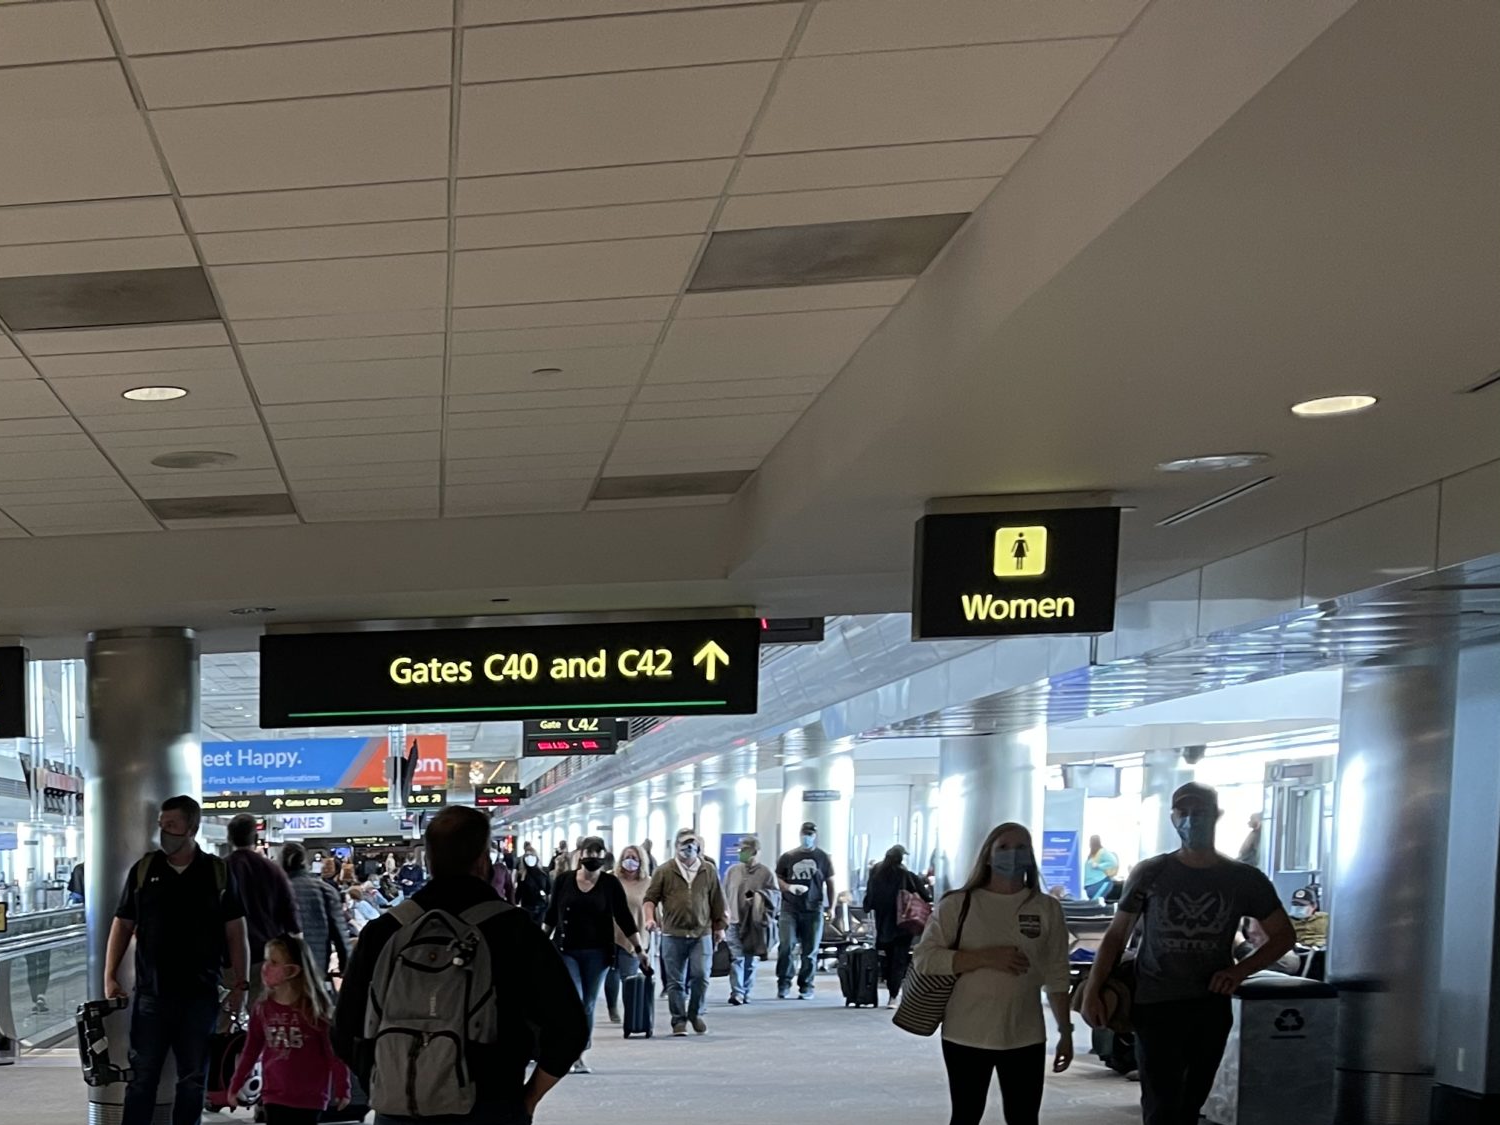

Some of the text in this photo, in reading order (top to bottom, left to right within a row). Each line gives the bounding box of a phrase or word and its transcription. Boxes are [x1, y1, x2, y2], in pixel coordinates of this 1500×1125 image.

[961, 594, 1075, 621] Women
[389, 648, 673, 685] Gates C40 and C42
[539, 720, 562, 730] Gate
[202, 751, 233, 767] eet
